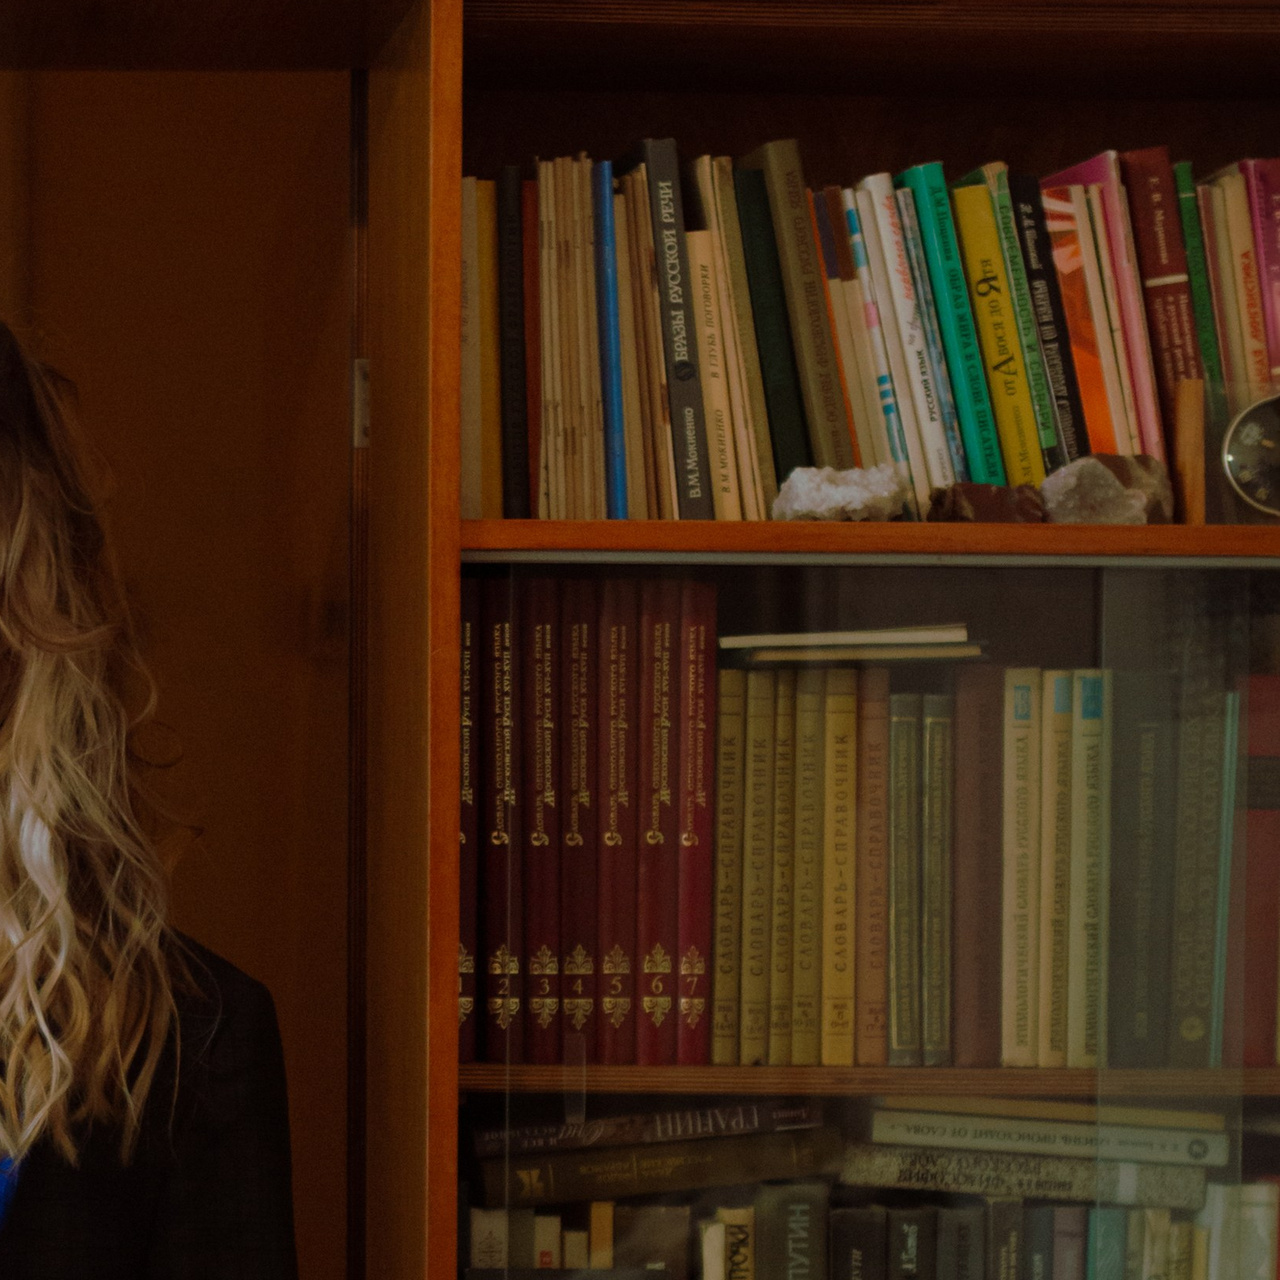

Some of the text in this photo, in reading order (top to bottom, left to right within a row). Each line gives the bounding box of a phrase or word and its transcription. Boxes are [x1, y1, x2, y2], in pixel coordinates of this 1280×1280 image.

[657, 179, 675, 222] РЕЧИ
[662, 229, 683, 304] РУССКОЙ
[700, 264, 715, 328] ПОГОВОРКИ
[999, 205, 1031, 337] СОВРЕМЕННОСТЬ
[1030, 359, 1051, 430] СЛОВАРИ
[707, 333, 720, 367] ГЛУБЬ
[915, 349, 931, 376] ЯЗЫК
[948, 268, 997, 478] ОБРАЗ МИРА СЛОВЕ ПИСАТЕЛЯ
[922, 379, 938, 422] РУССКИЙ
[714, 409, 729, 469] МОКИЕНКО
[719, 736, 736, 975] СЛОВАРЬ-СПРАВОЧНИК
[750, 736, 767, 977] СЛОВАРЬ-СПРАВОЧНИК
[776, 736, 791, 974] СЛОВАРЬ-СПРАВОЧНИК
[799, 735, 816, 971] СЛОВАРЬ-СПРАВОЧНИК
[834, 736, 850, 972] СЛОВАРЬ-СПРАВОЧНИК
[869, 742, 885, 970] СЛОВАРЬ-СПРАВОЧНИК
[498, 977, 511, 995] 2
[539, 977, 551, 994] 3
[571, 977, 585, 994] 4
[610, 977, 622, 994] 5
[651, 976, 664, 994] 6
[686, 977, 698, 994] 7
[654, 1105, 759, 1139] ГРАНИН
